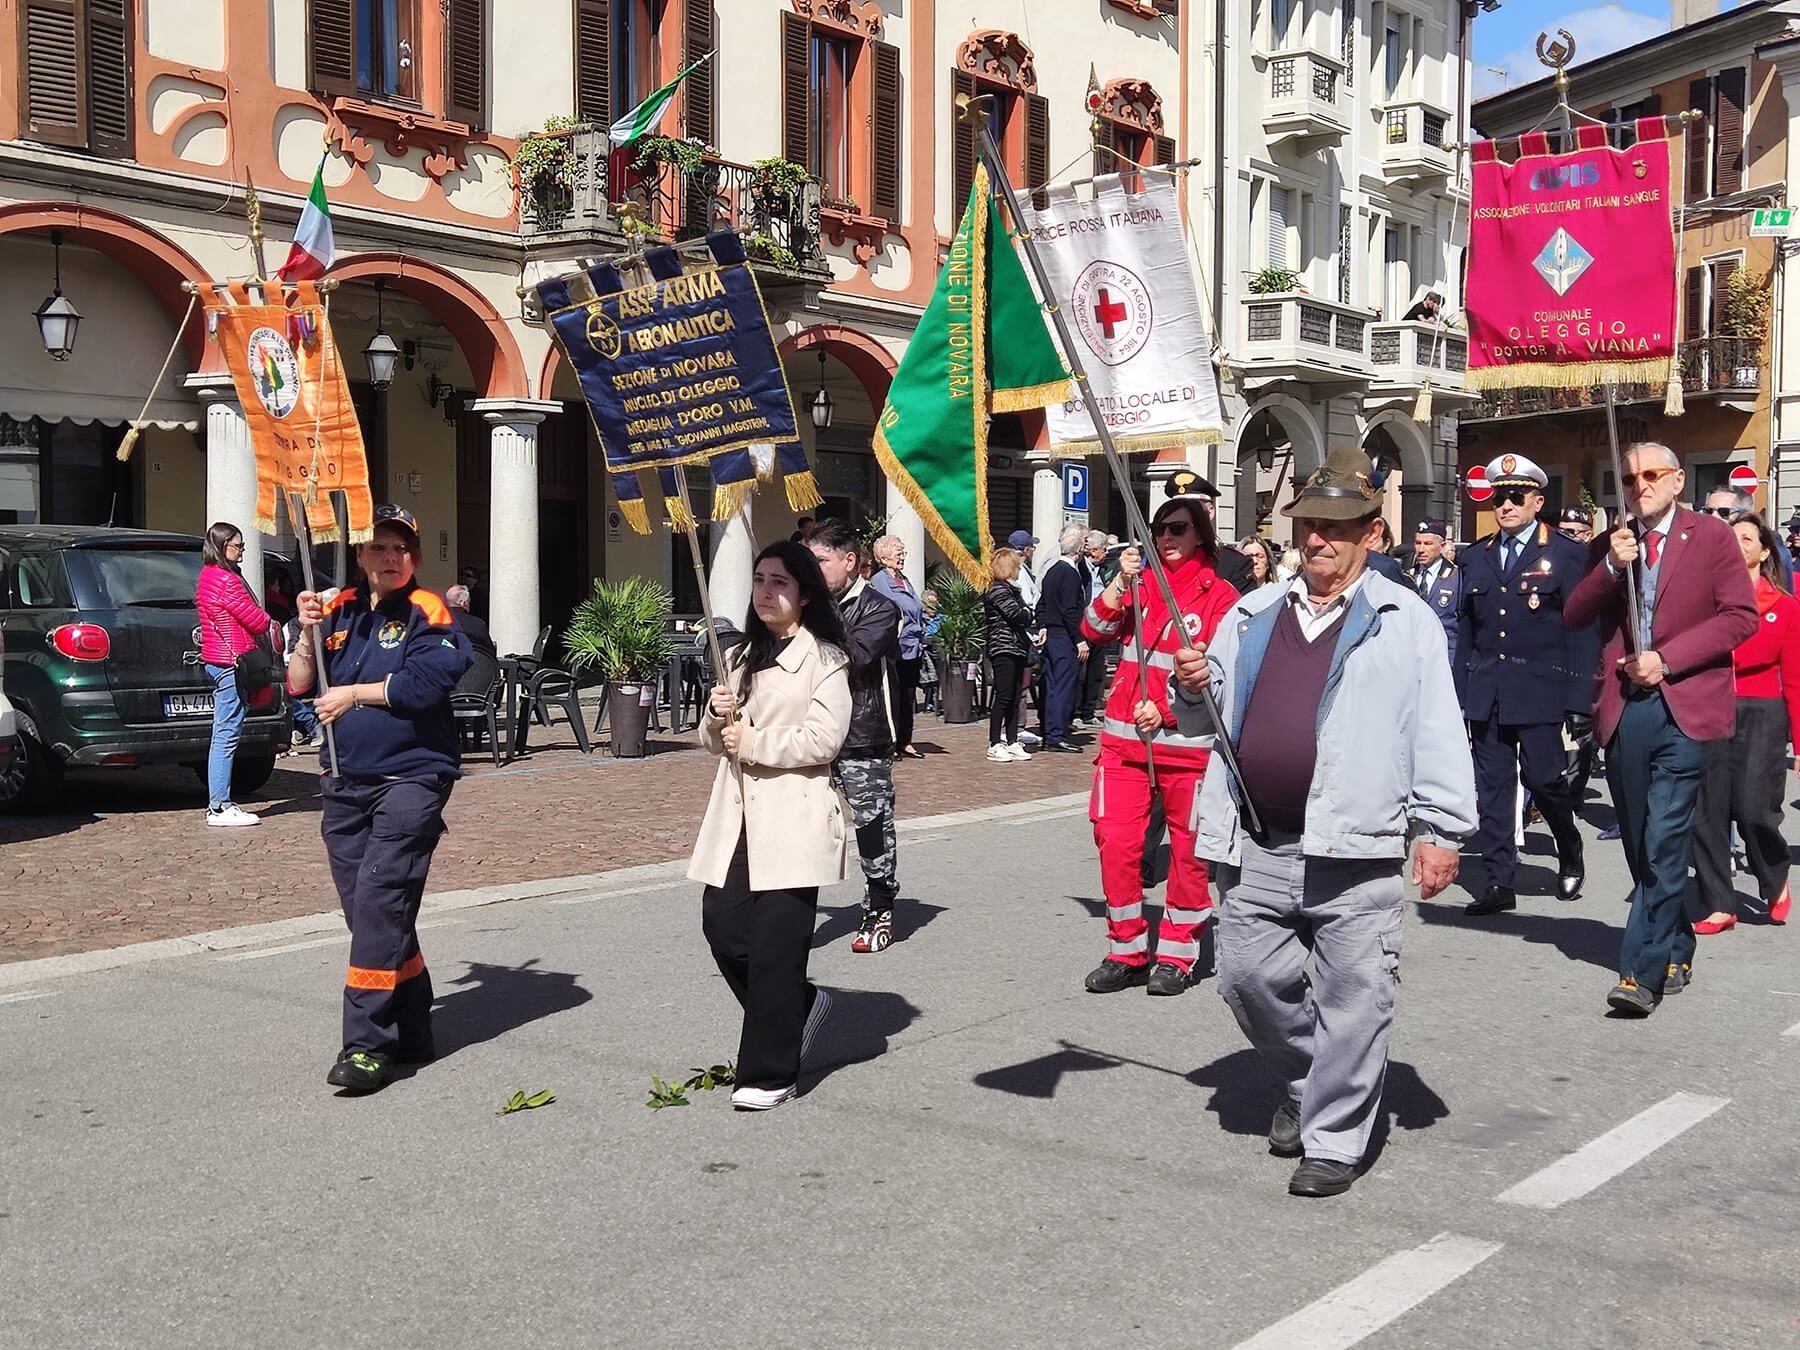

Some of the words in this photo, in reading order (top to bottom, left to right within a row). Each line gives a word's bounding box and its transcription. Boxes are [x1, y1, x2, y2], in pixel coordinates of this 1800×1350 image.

[1529, 161, 1600, 191] AVIS
[1474, 202, 1530, 219] ASSOCIAZIONE
[1535, 198, 1580, 214] VOLONTARI
[1584, 195, 1620, 209] ITALIANI
[1623, 188, 1660, 207] SANGUE
[1070, 217, 1106, 234] ROSSA
[1110, 208, 1164, 228] ITALIANA
[662, 270, 727, 309] ARMA
[947, 294, 968, 313] DI
[1119, 274, 1132, 288] 22
[1130, 288, 1148, 336] AGOSTO
[628, 309, 736, 353] AERONAUTICA
[1508, 320, 1626, 341] OLEGGIO
[1534, 308, 1592, 323] COMUNALE
[612, 367, 658, 391] SEZIONE
[660, 367, 672, 378] DI
[672, 350, 737, 378] NOVARA
[948, 322, 969, 400] NOVARA
[623, 394, 661, 413] NUCLEO
[661, 390, 677, 406] DI
[678, 375, 741, 400] OLEGGIO
[1120, 389, 1179, 409] LOCALE
[1182, 386, 1196, 401] DI
[677, 402, 724, 427] D'ORO
[729, 397, 757, 414] V.M.
[1068, 469, 1083, 505] P
